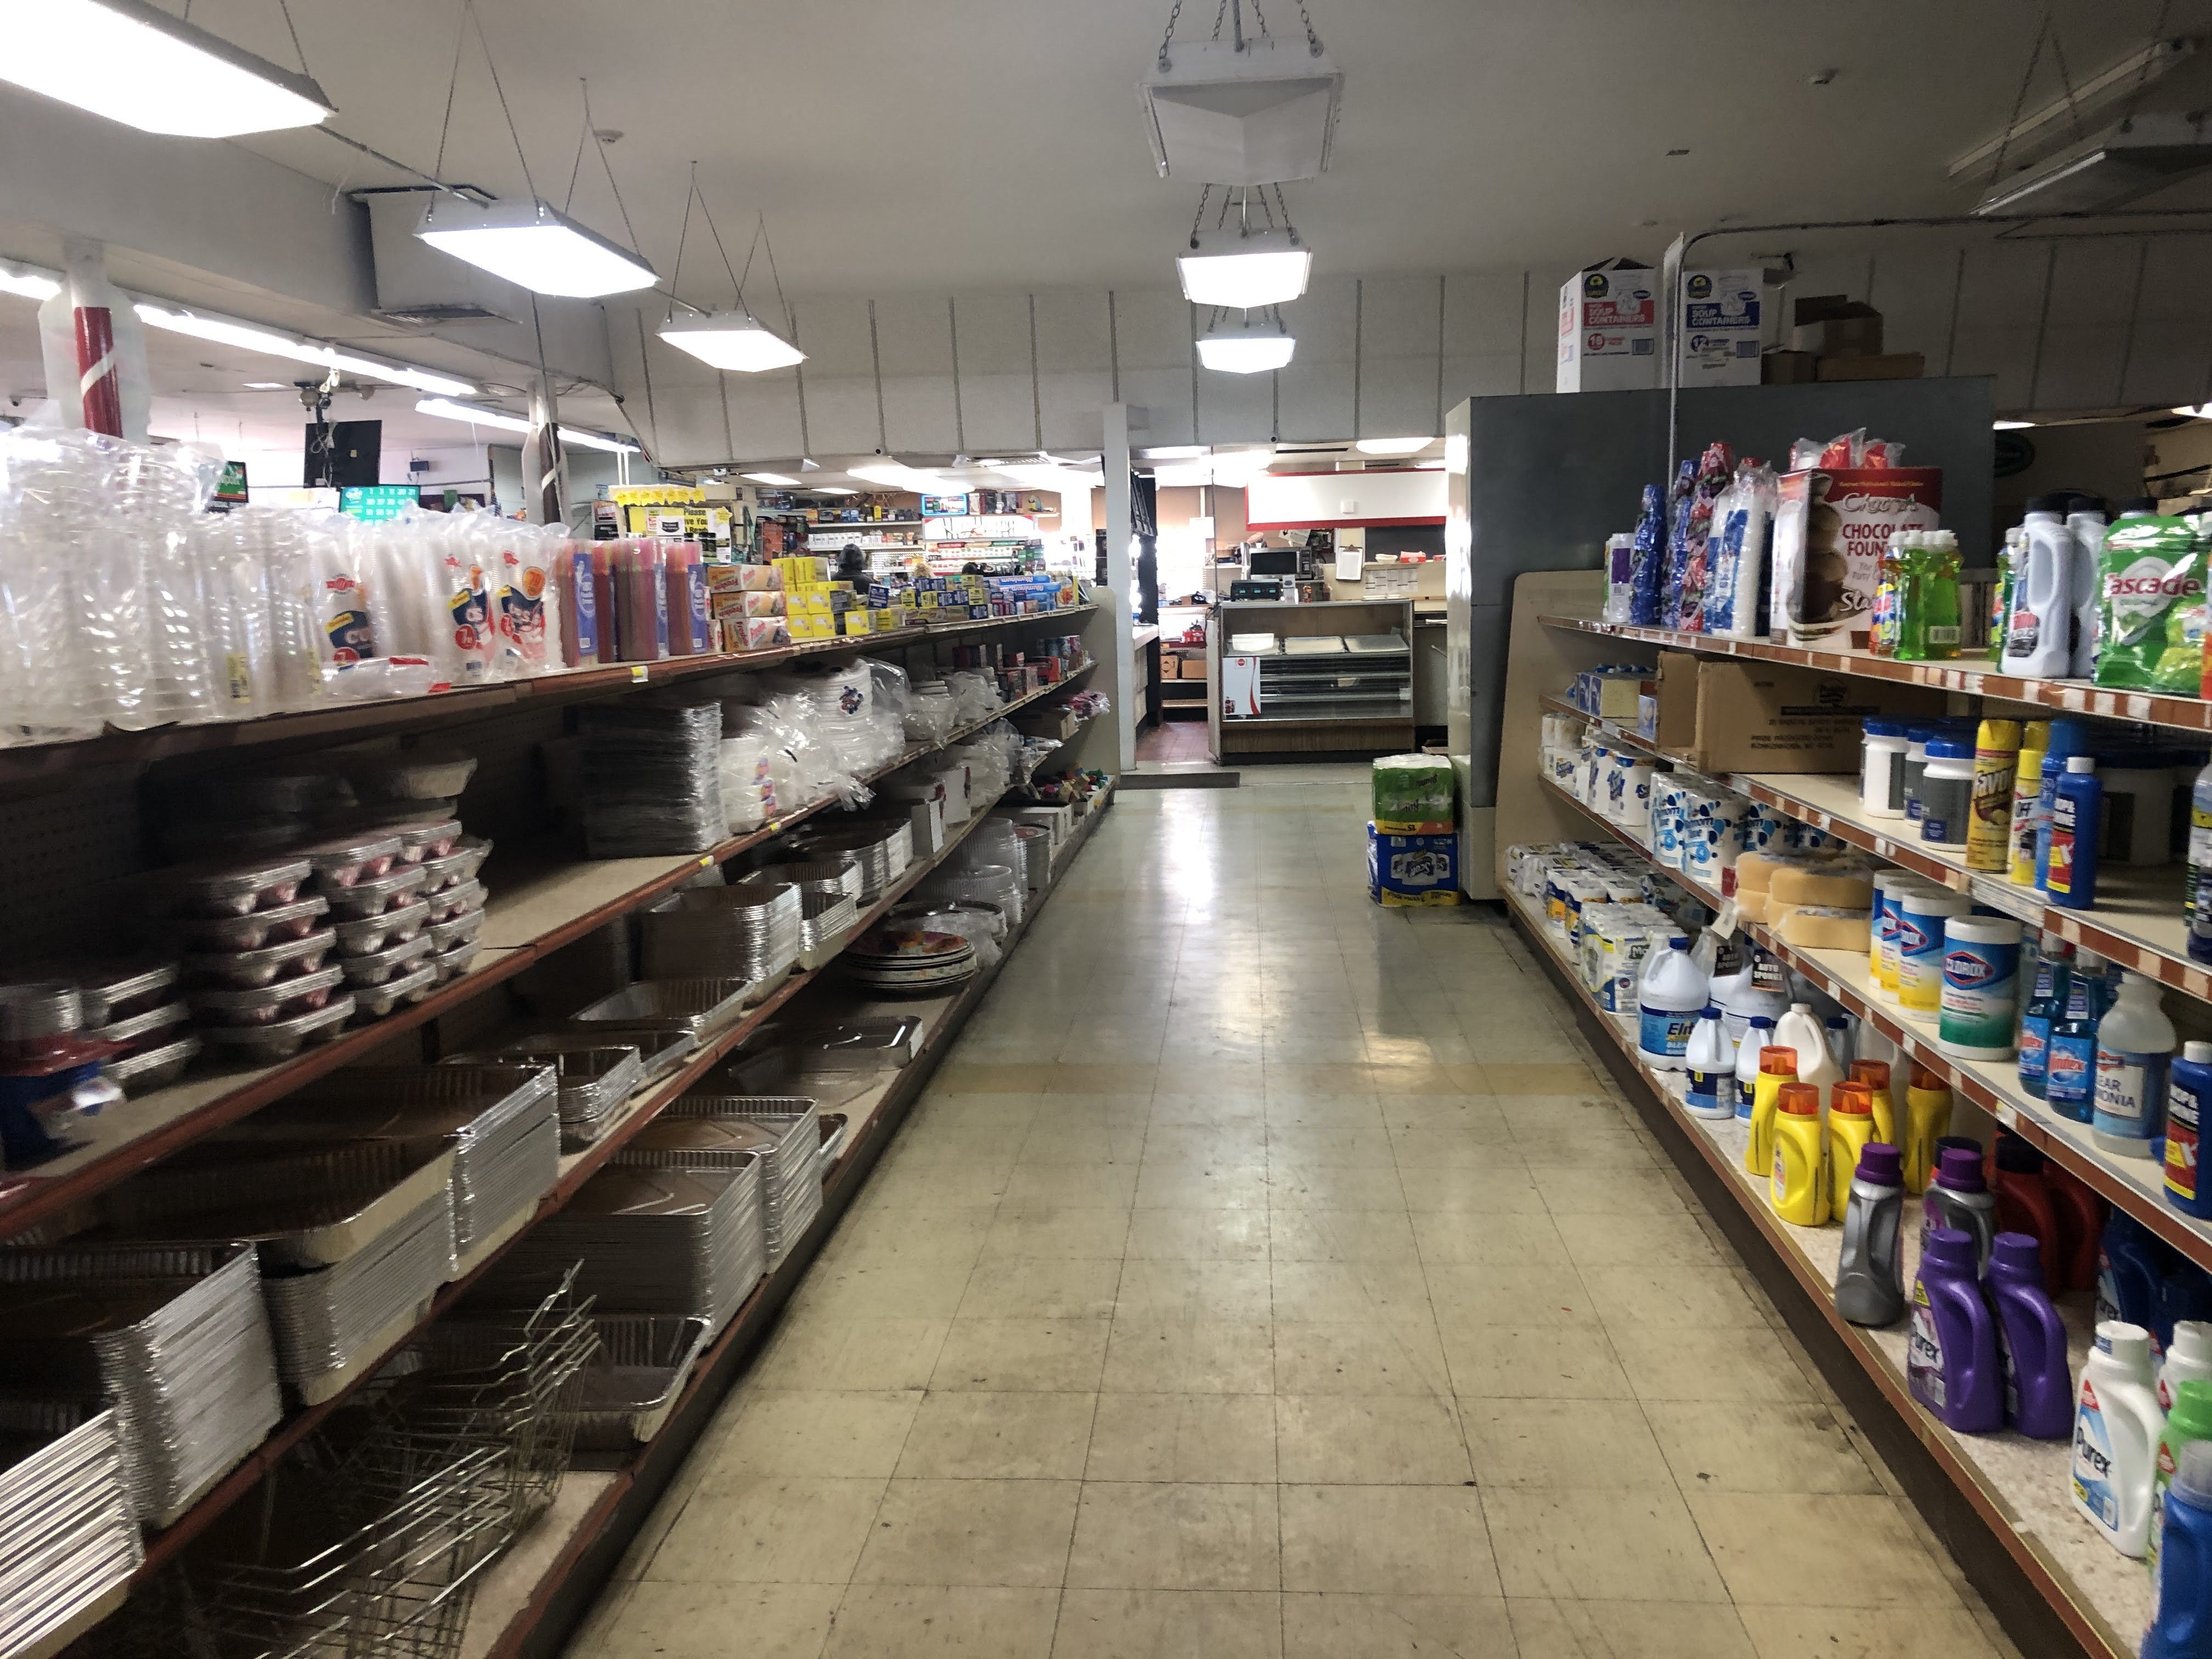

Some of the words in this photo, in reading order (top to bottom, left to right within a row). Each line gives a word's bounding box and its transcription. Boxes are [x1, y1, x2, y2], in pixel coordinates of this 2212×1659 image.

[1589, 307, 1613, 315] SOUP
[1589, 314, 1645, 324] CONTAINERS
[1692, 315, 1751, 325] CONTAINERS
[1847, 540, 1888, 557] FOUN
[1758, 963, 1780, 972] AUTO
[1945, 958, 1987, 977] CLOROX
[2098, 1075, 2121, 1092] EAR
[2098, 1087, 2136, 1109] ONIA
[2076, 1425, 2113, 1478] Purex
